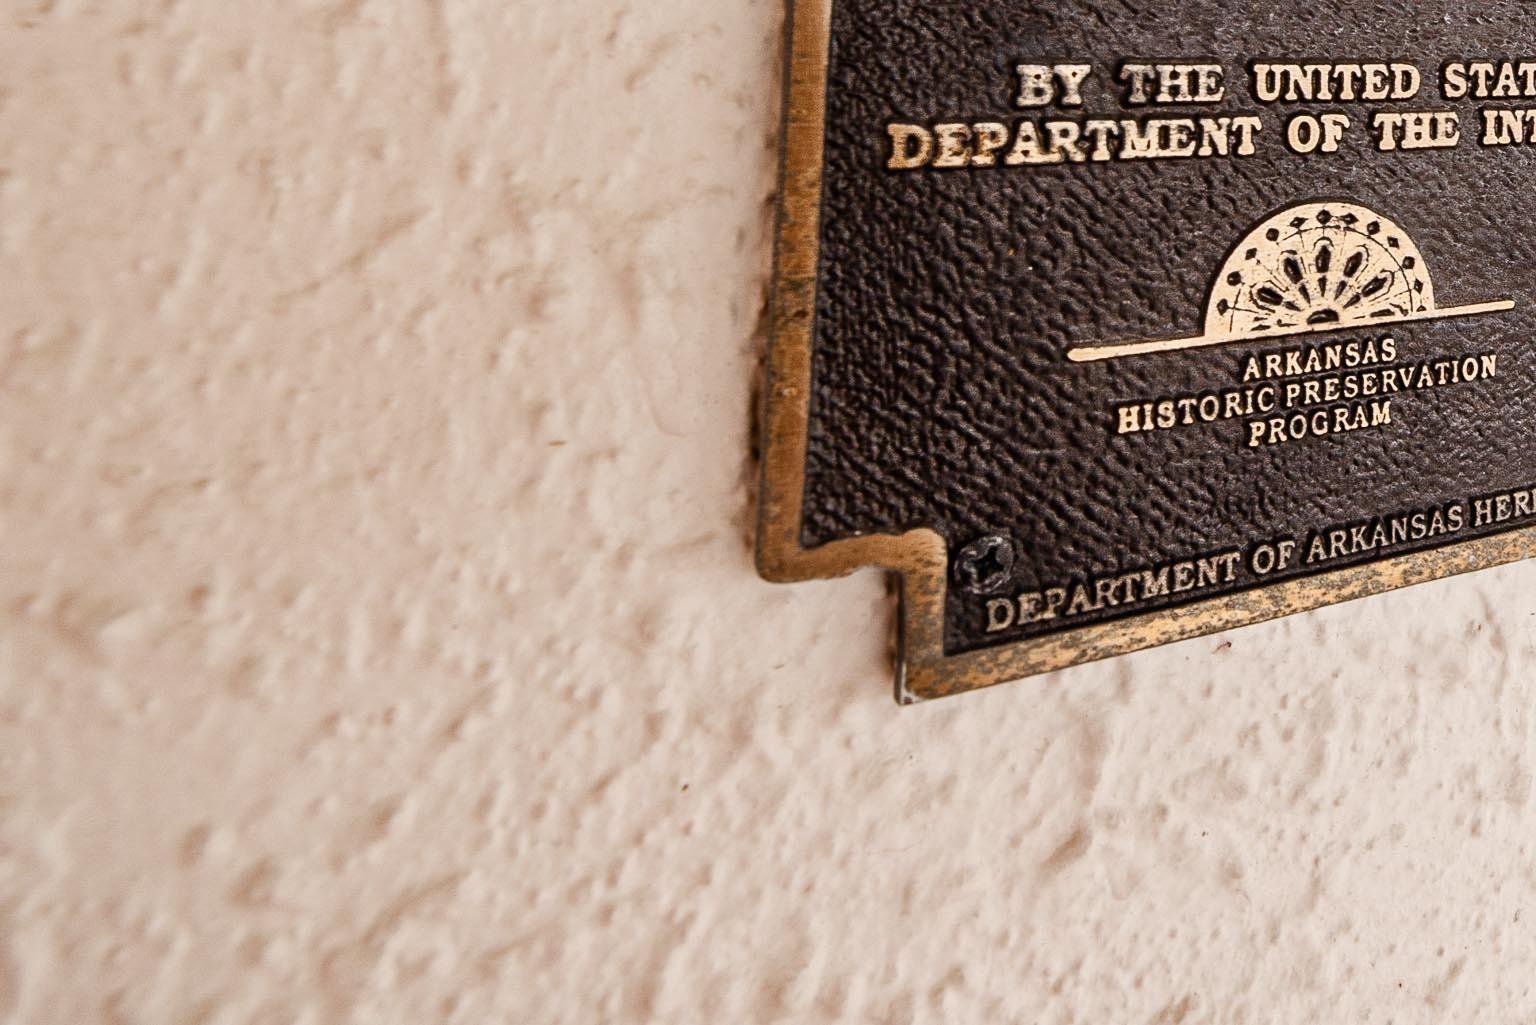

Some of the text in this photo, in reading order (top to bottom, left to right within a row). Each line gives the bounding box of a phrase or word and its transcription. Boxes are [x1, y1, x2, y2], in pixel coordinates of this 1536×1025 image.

[1017, 65, 1091, 105] BY
[1122, 64, 1225, 103] THE
[1254, 64, 1420, 100] UNITED
[888, 117, 1262, 167] DEPARTMENT
[1288, 114, 1350, 152] OF
[1373, 111, 1461, 151] THE
[1243, 338, 1398, 383] ARKANSAS
[1117, 353, 1497, 435] HISTORIC PRESERVATION
[1248, 401, 1392, 447] PROGRAM
[984, 551, 1240, 633] DEPARTMENT
[1253, 541, 1295, 573] OF
[1307, 506, 1462, 562] ARKANSAS
